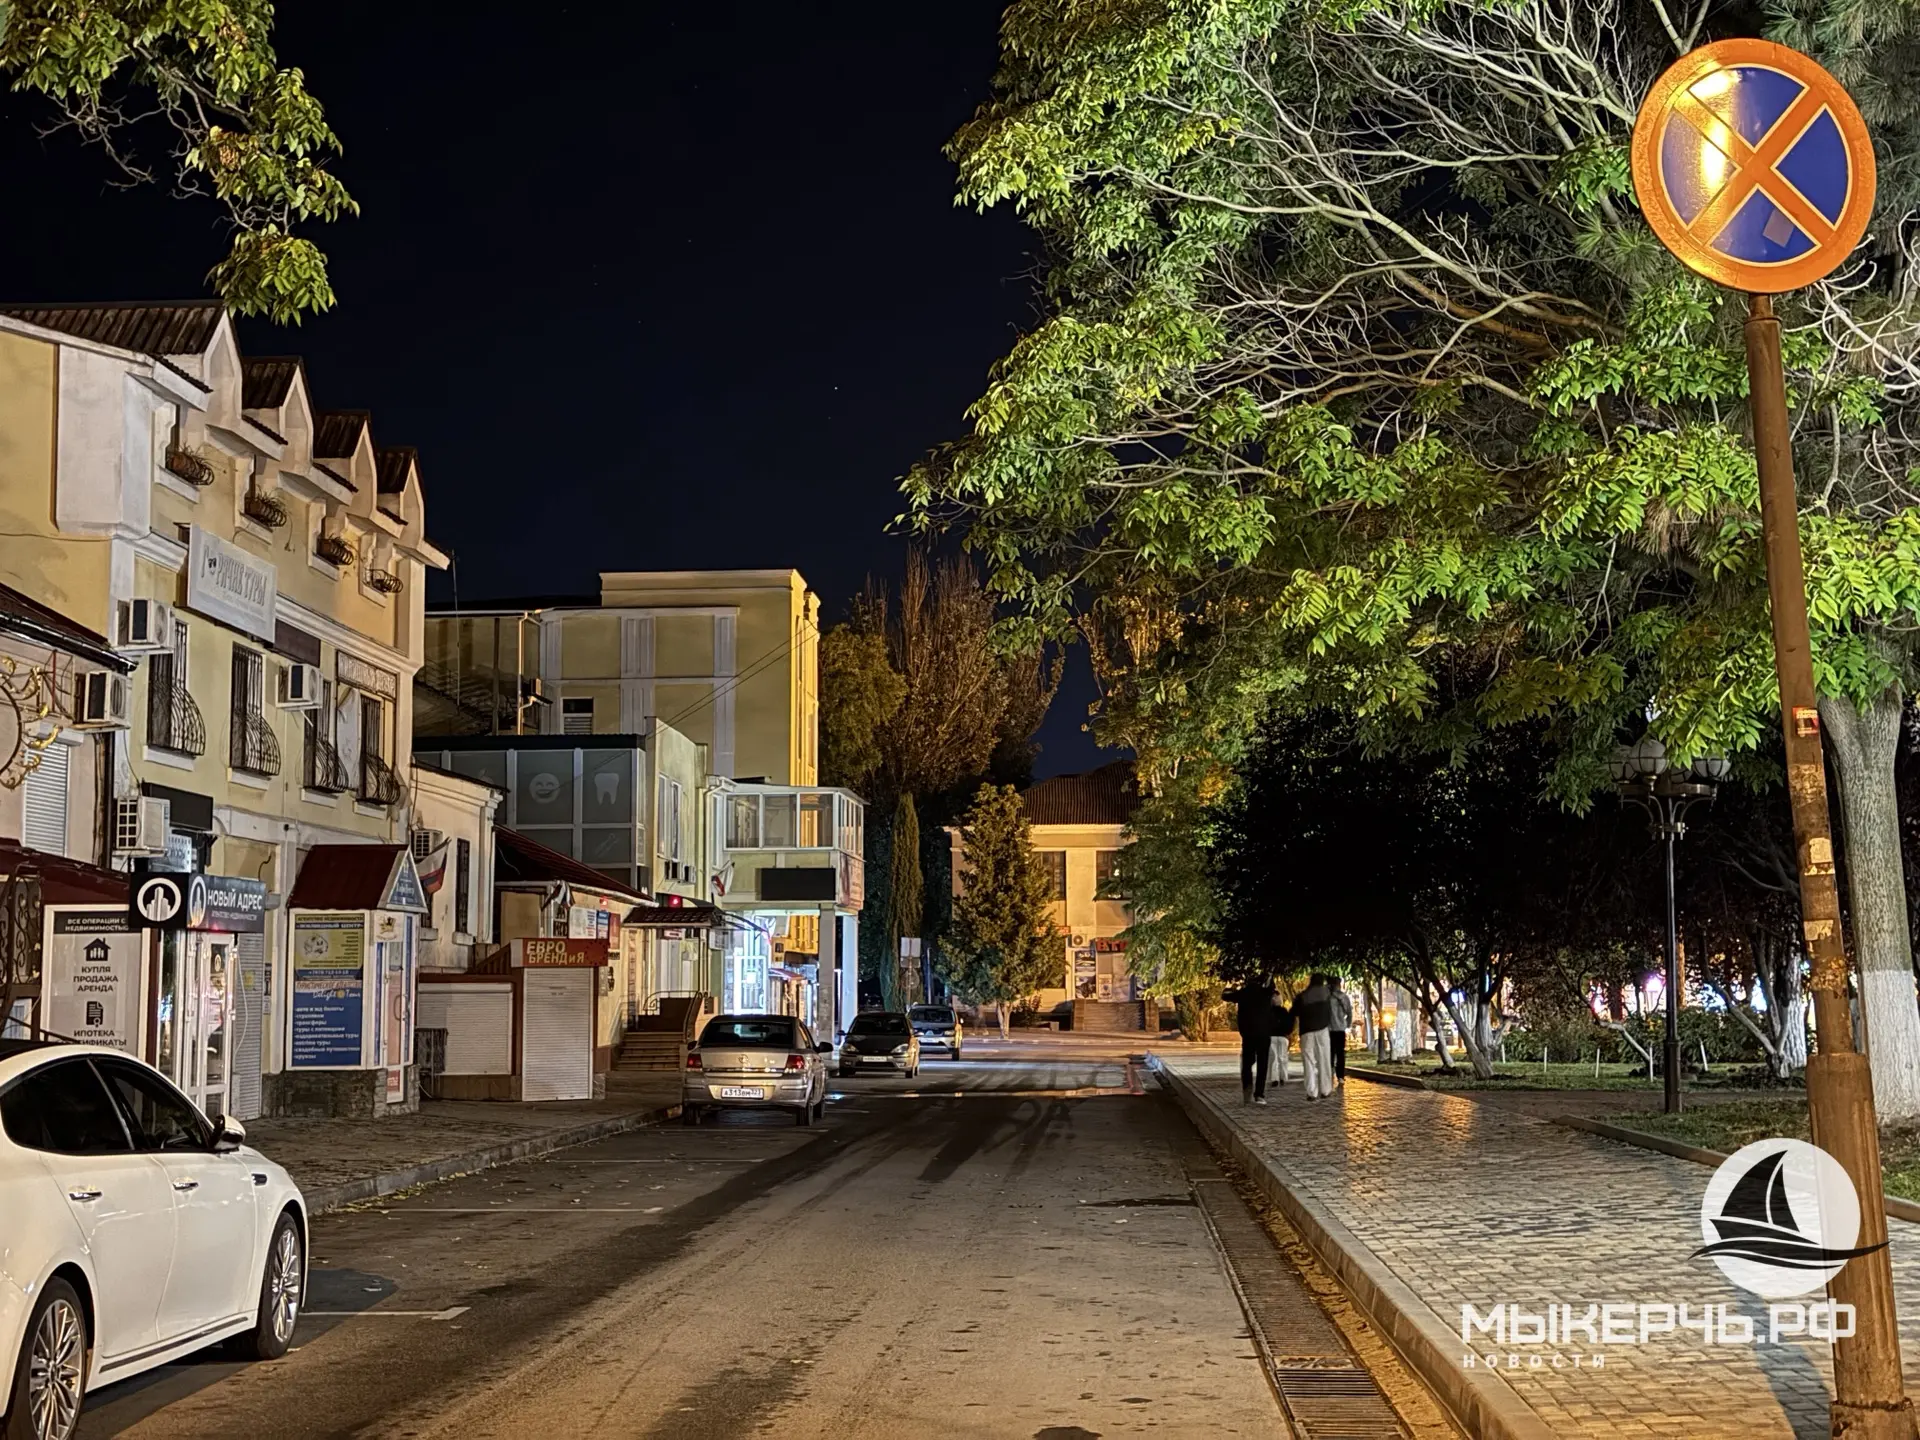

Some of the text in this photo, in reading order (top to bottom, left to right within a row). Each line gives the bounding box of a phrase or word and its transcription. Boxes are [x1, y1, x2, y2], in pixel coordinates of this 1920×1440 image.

[207, 888, 262, 912] НОВЫЙ АДРЕС
[527, 941, 566, 955] ЕВРО
[529, 951, 585, 965] БРЕНДиЯ
[73, 975, 118, 983] ПРОДАЖА
